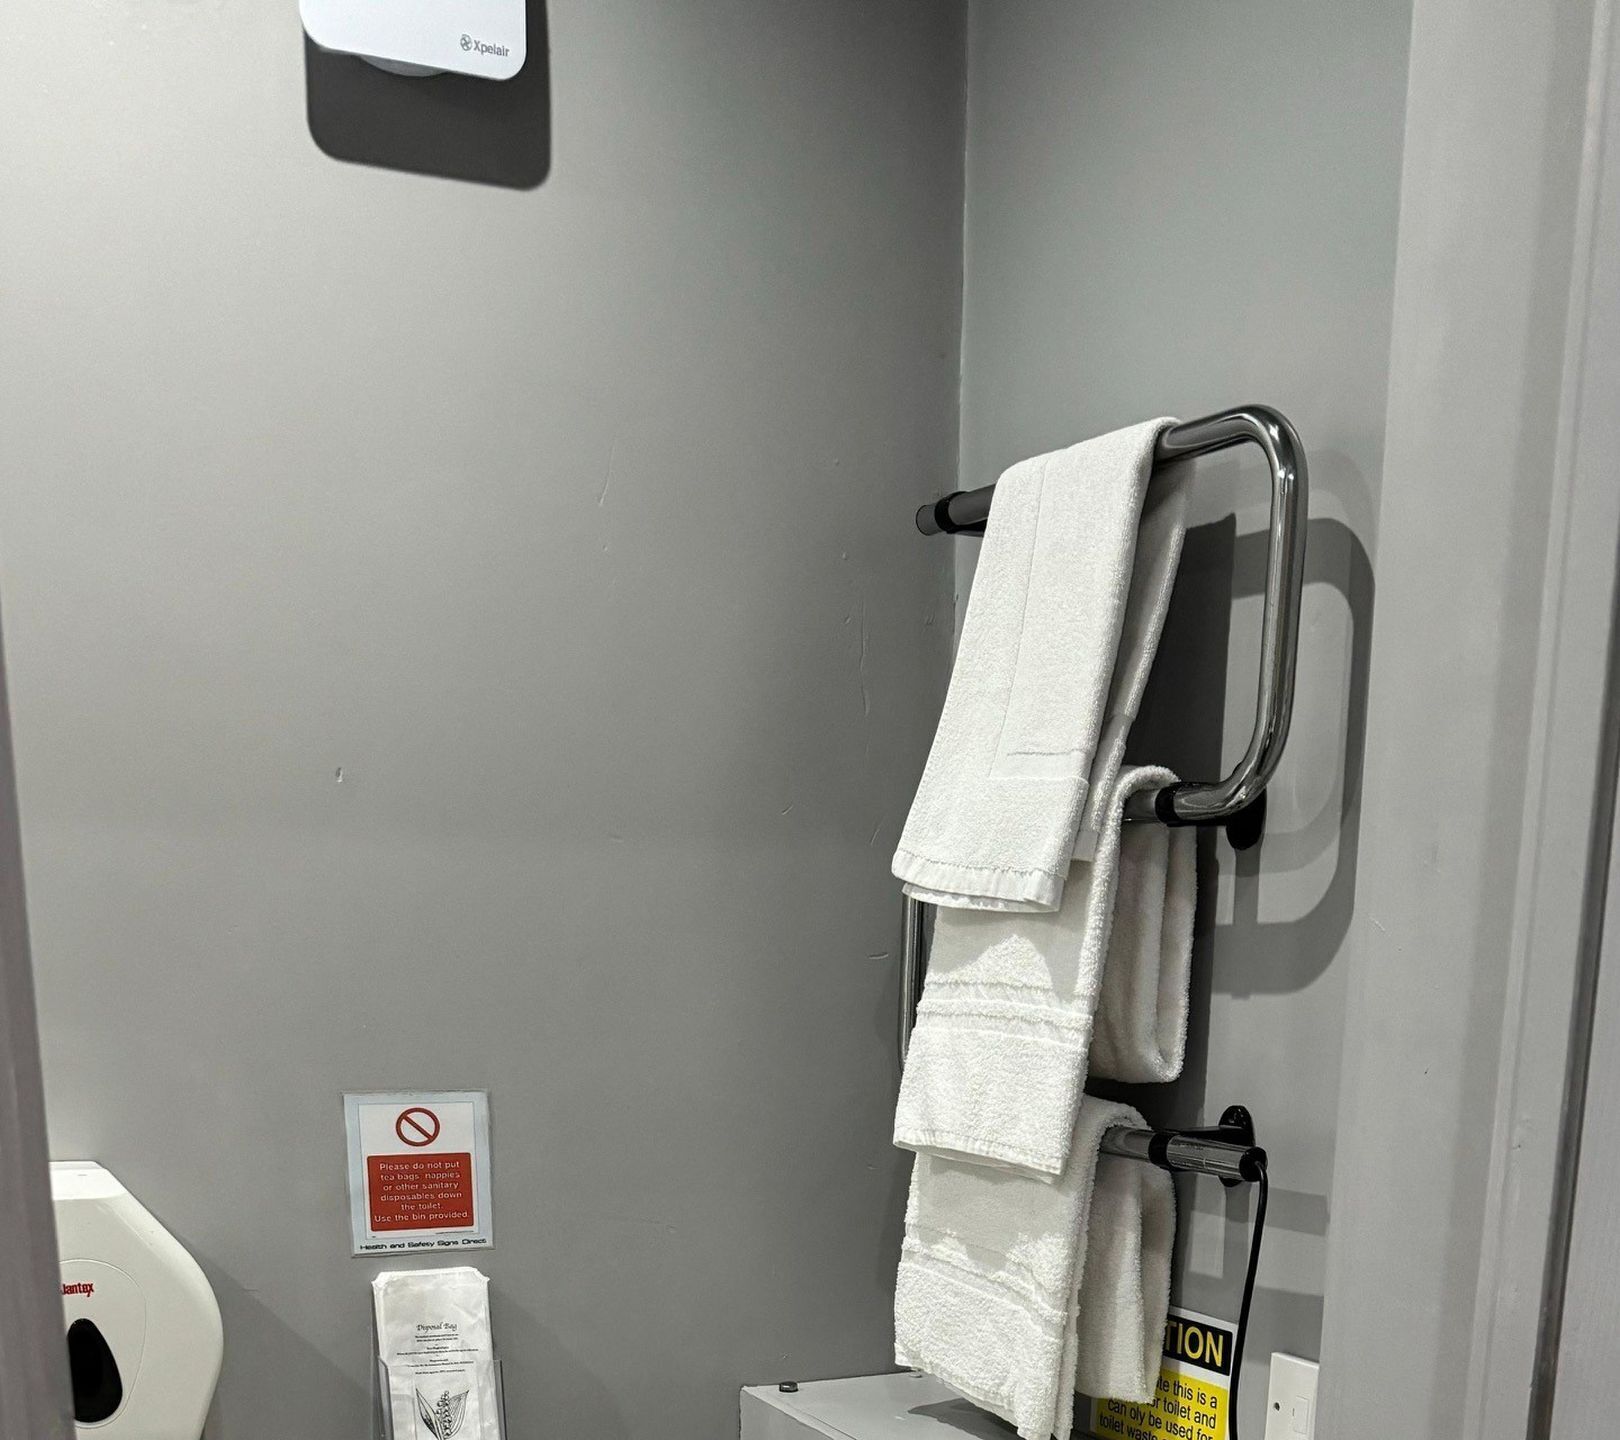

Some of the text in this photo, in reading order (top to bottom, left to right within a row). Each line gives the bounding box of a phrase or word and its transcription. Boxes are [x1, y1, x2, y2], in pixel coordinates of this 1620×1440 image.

[474, 40, 510, 56] Xpelair
[381, 1194, 435, 1202] disposables
[416, 1322, 457, 1333] Disposal Bag
[1165, 1321, 1223, 1367] TION
[1174, 1381, 1193, 1400] this
[1197, 1388, 1206, 1404] is
[1210, 1396, 1217, 1409] a
[1100, 1412, 1125, 1434] toilet
[1108, 1400, 1126, 1414] can
[1130, 1406, 1145, 1425] oly
[1149, 1411, 1162, 1429] be
[1166, 1421, 1192, 1440] used
[1164, 1397, 1191, 1420] toilet
[1194, 1412, 1216, 1429] and
